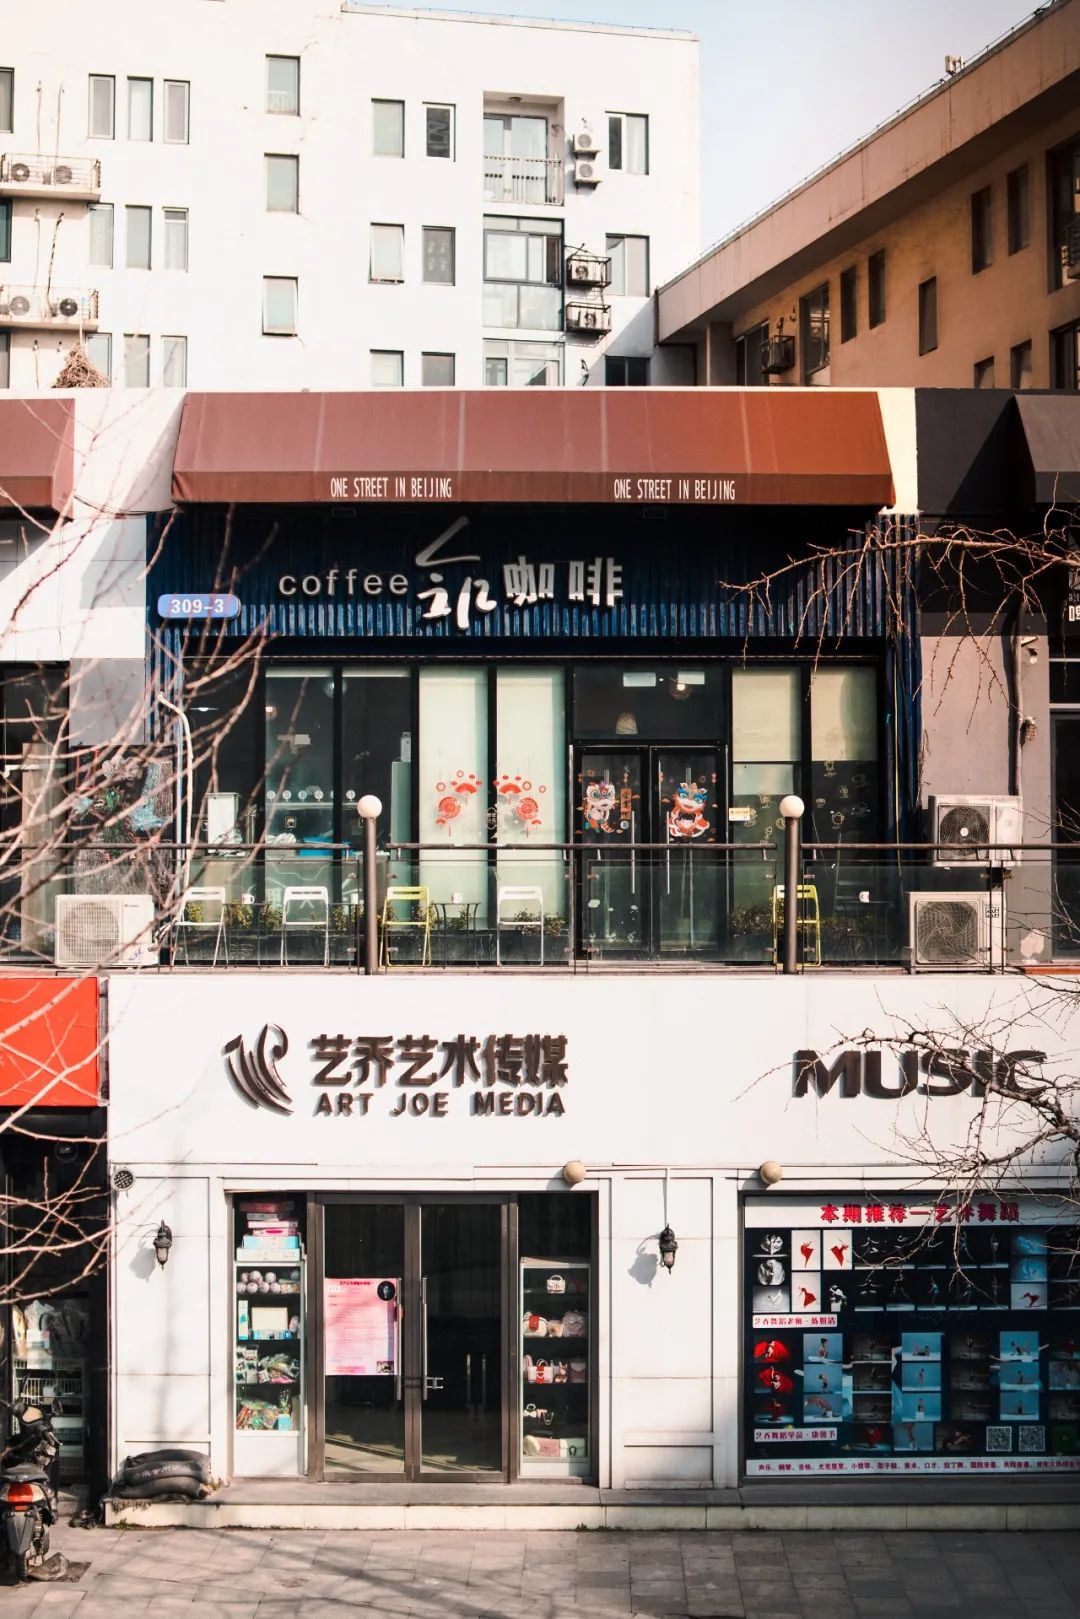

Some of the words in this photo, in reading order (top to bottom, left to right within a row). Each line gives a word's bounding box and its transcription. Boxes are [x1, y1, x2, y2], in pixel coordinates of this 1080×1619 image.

[330, 477, 348, 498] ONE
[353, 477, 388, 498] STREET
[395, 477, 406, 498] IN
[411, 477, 452, 498] BEIJING
[613, 479, 632, 500] ONE
[637, 479, 672, 500] STREET
[678, 479, 690, 500] IN
[694, 479, 736, 500] BEIJING
[278, 568, 409, 597] coffee
[502, 555, 624, 608] 咖啡
[170, 598, 225, 614] 309-3
[309, 1033, 569, 1088] 艺乔艺术传媒
[792, 1048, 1048, 1099] MUSIC
[313, 1091, 374, 1116] ART
[390, 1091, 450, 1116] JOE
[470, 1091, 567, 1117] MEDIA
